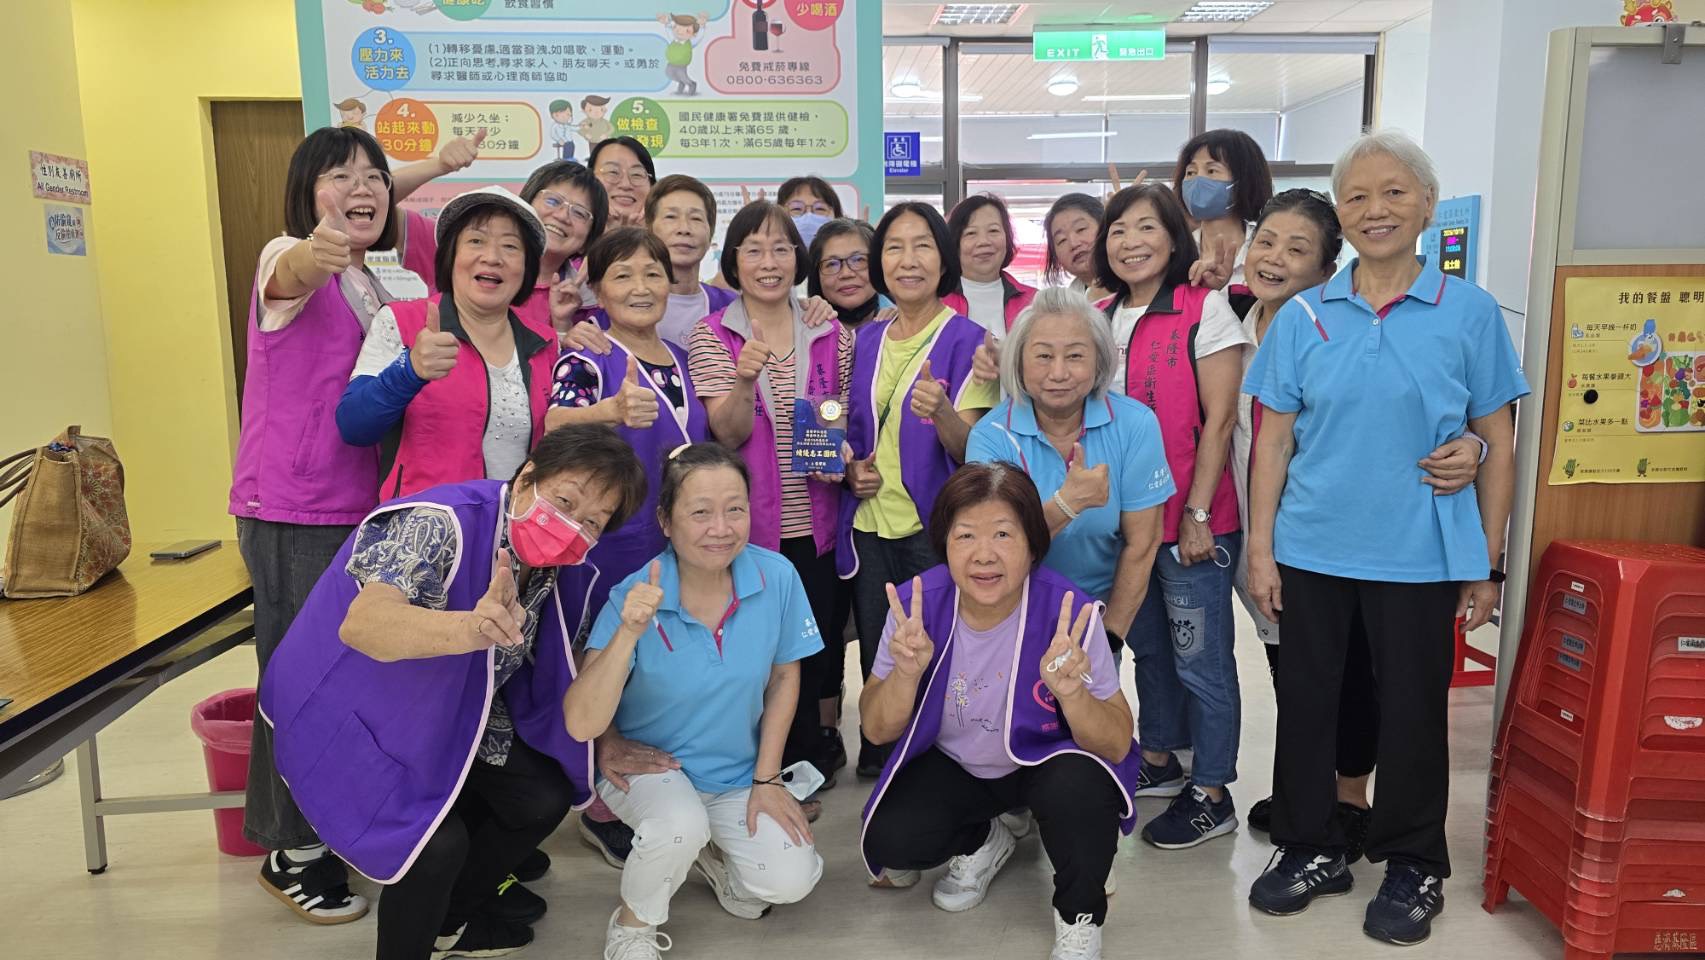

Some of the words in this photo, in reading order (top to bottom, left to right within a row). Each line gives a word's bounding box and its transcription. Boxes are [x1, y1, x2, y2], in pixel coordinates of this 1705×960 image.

[796, 3, 838, 17] 少喝酒
[359, 48, 404, 62] 壓力來
[1047, 48, 1079, 57] EXIT
[365, 65, 410, 80] 活力去
[739, 61, 810, 72] 免費戒菸專線
[377, 121, 435, 135] 站起來動
[617, 117, 658, 131] 做檢查
[384, 139, 433, 152] 30分鐘
[1618, 292, 1671, 304] 我的餐盤
